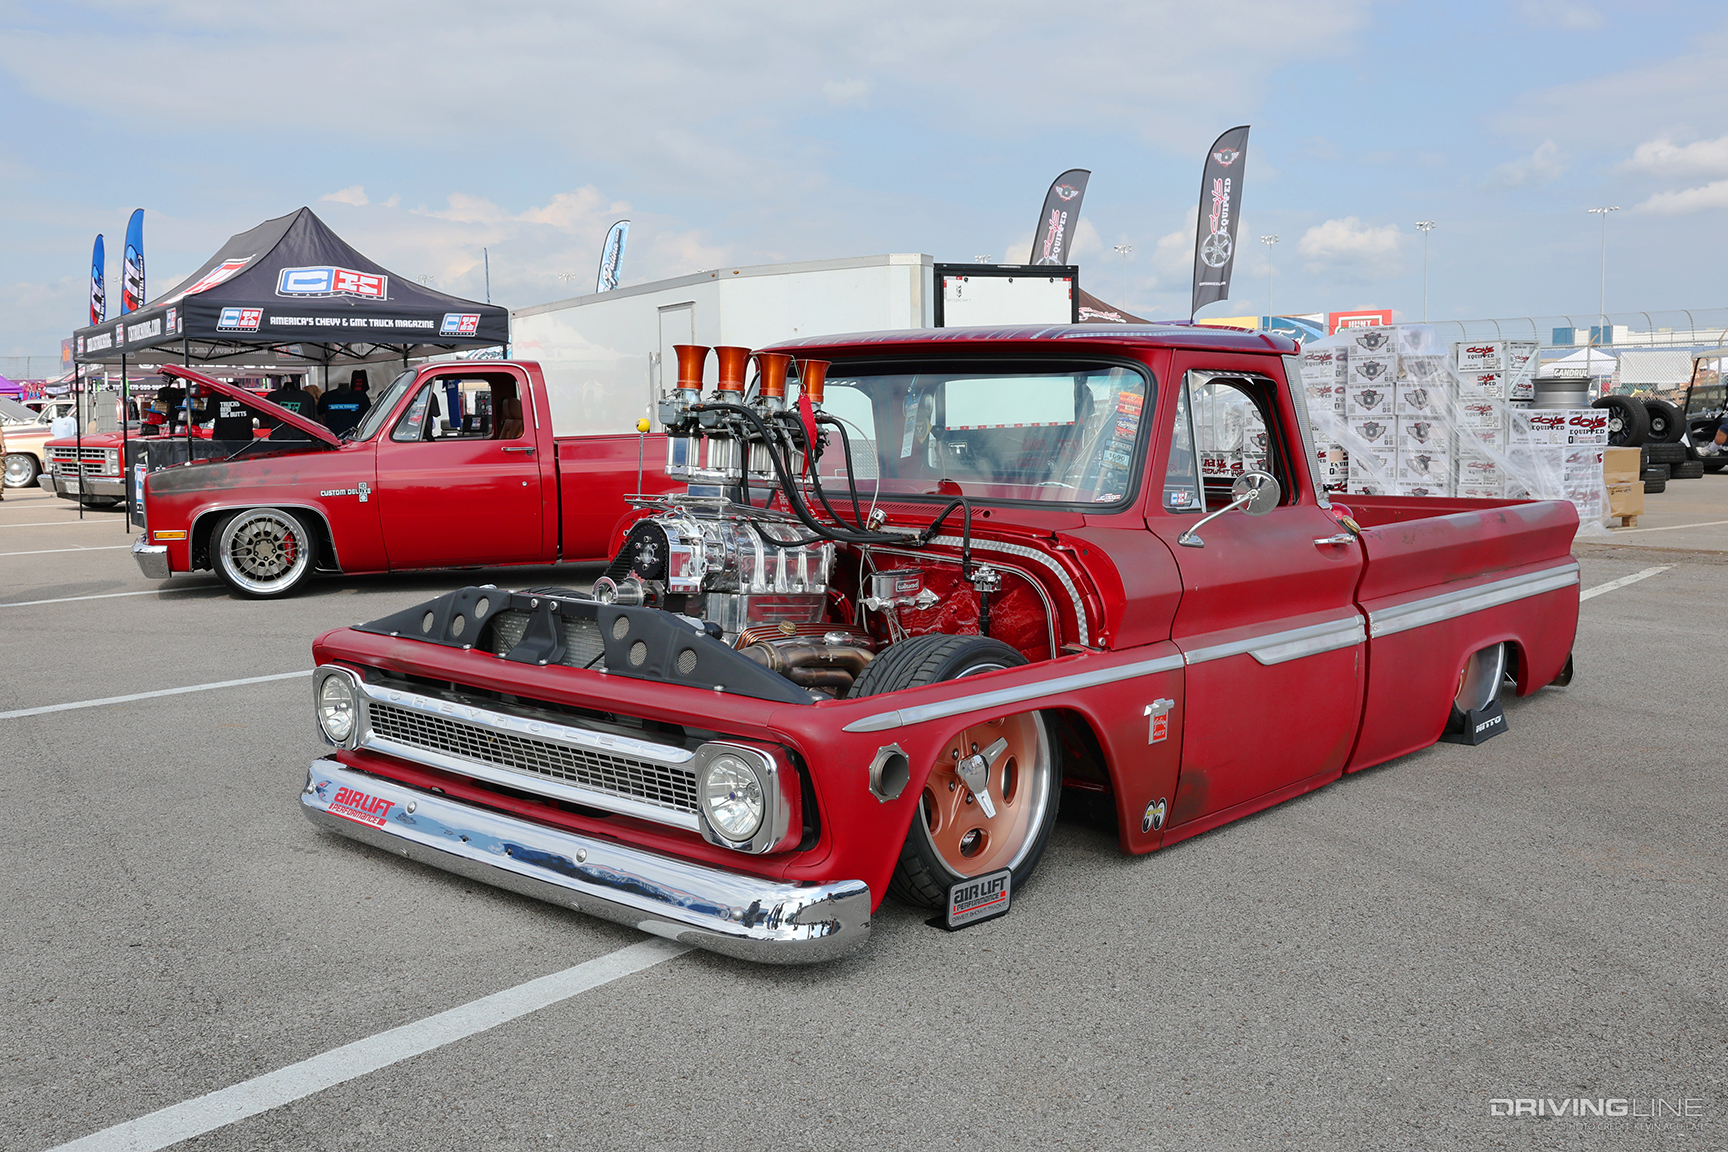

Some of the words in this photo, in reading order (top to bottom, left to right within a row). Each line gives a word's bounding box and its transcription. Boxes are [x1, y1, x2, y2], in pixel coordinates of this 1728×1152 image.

[270, 317, 314, 325] AMERICA'S
[369, 319, 394, 327] TRUCK
[395, 320, 434, 328] MAGAZINE
[388, 691, 652, 754] CHEVROLET
[1476, 715, 1502, 733] NITTO
[332, 803, 379, 824] PERFORMANCE
[956, 892, 999, 911] PERFORMANCE
